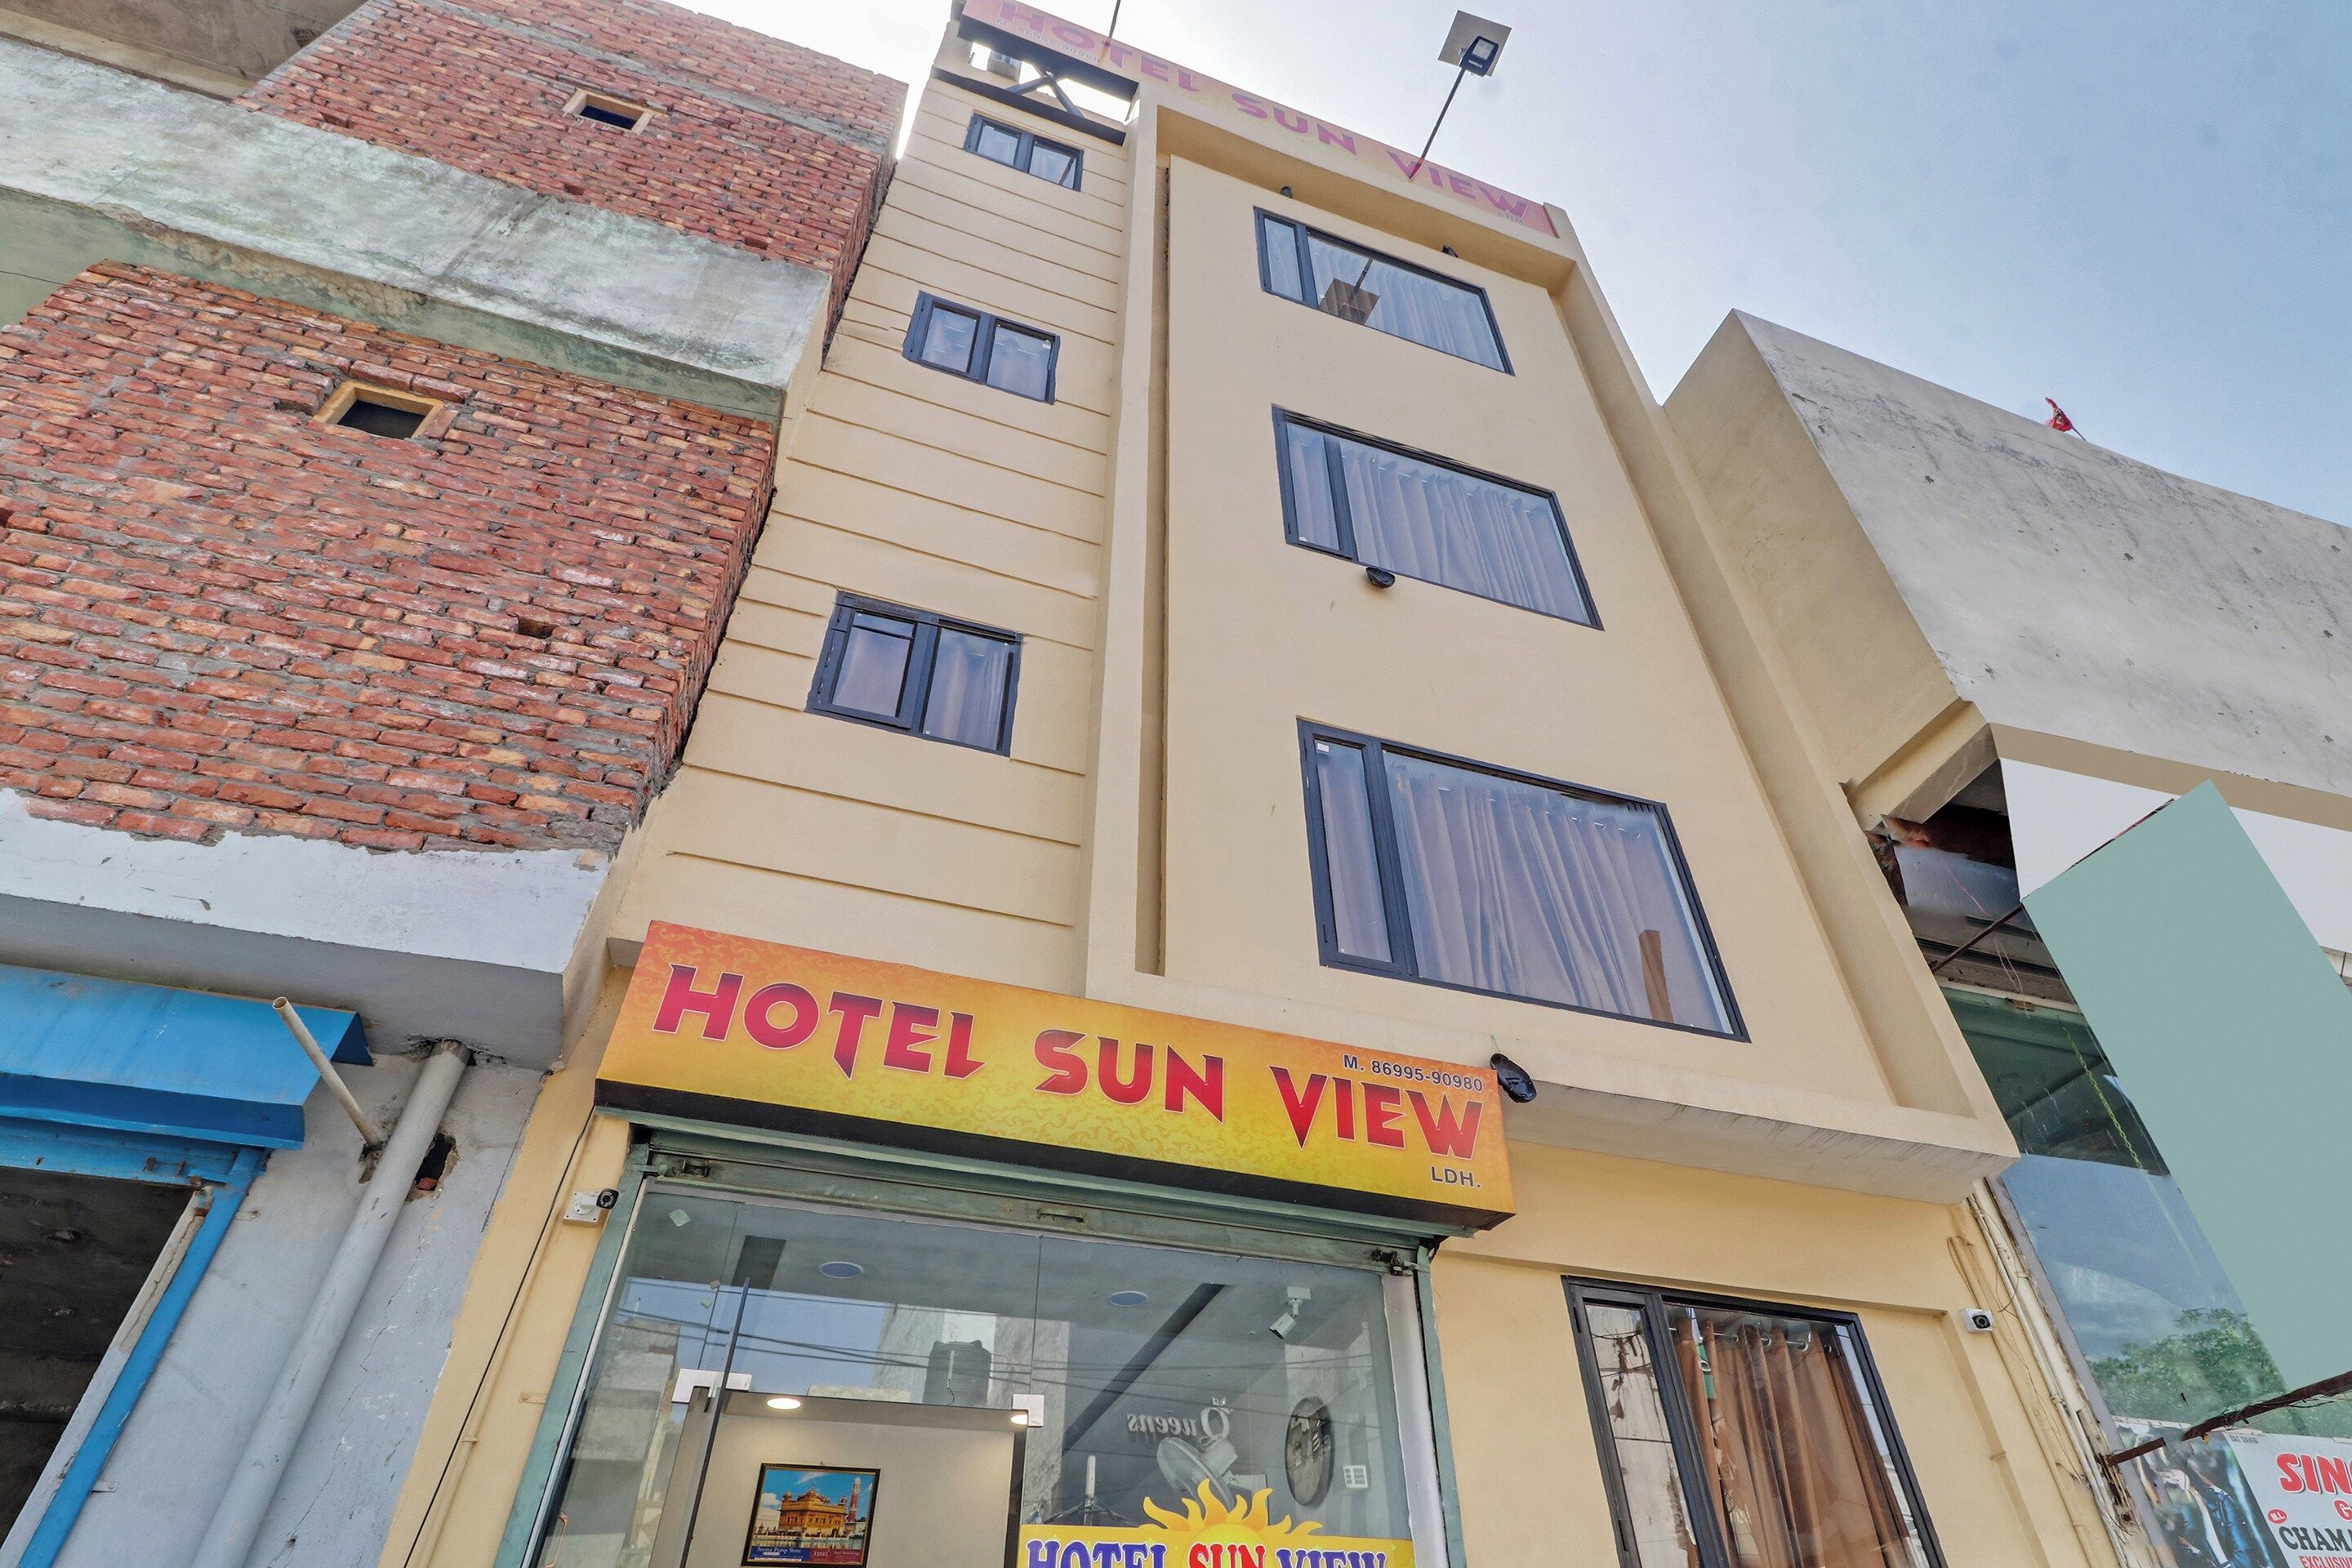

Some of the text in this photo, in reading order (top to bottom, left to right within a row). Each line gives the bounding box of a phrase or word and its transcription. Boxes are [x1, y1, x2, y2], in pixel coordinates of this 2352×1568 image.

[998, 1, 1200, 93] HOTEL
[1232, 92, 1358, 157] SUN
[1386, 150, 1529, 218] VIEW
[653, 963, 1484, 1160] HOTEL SUN VIEW
[1343, 1054, 1484, 1093] M. 86995-90980
[1430, 1165, 1482, 1189] LDH.
[2276, 1452, 2352, 1494] SIN
[2278, 1526, 2352, 1552] CHAM
